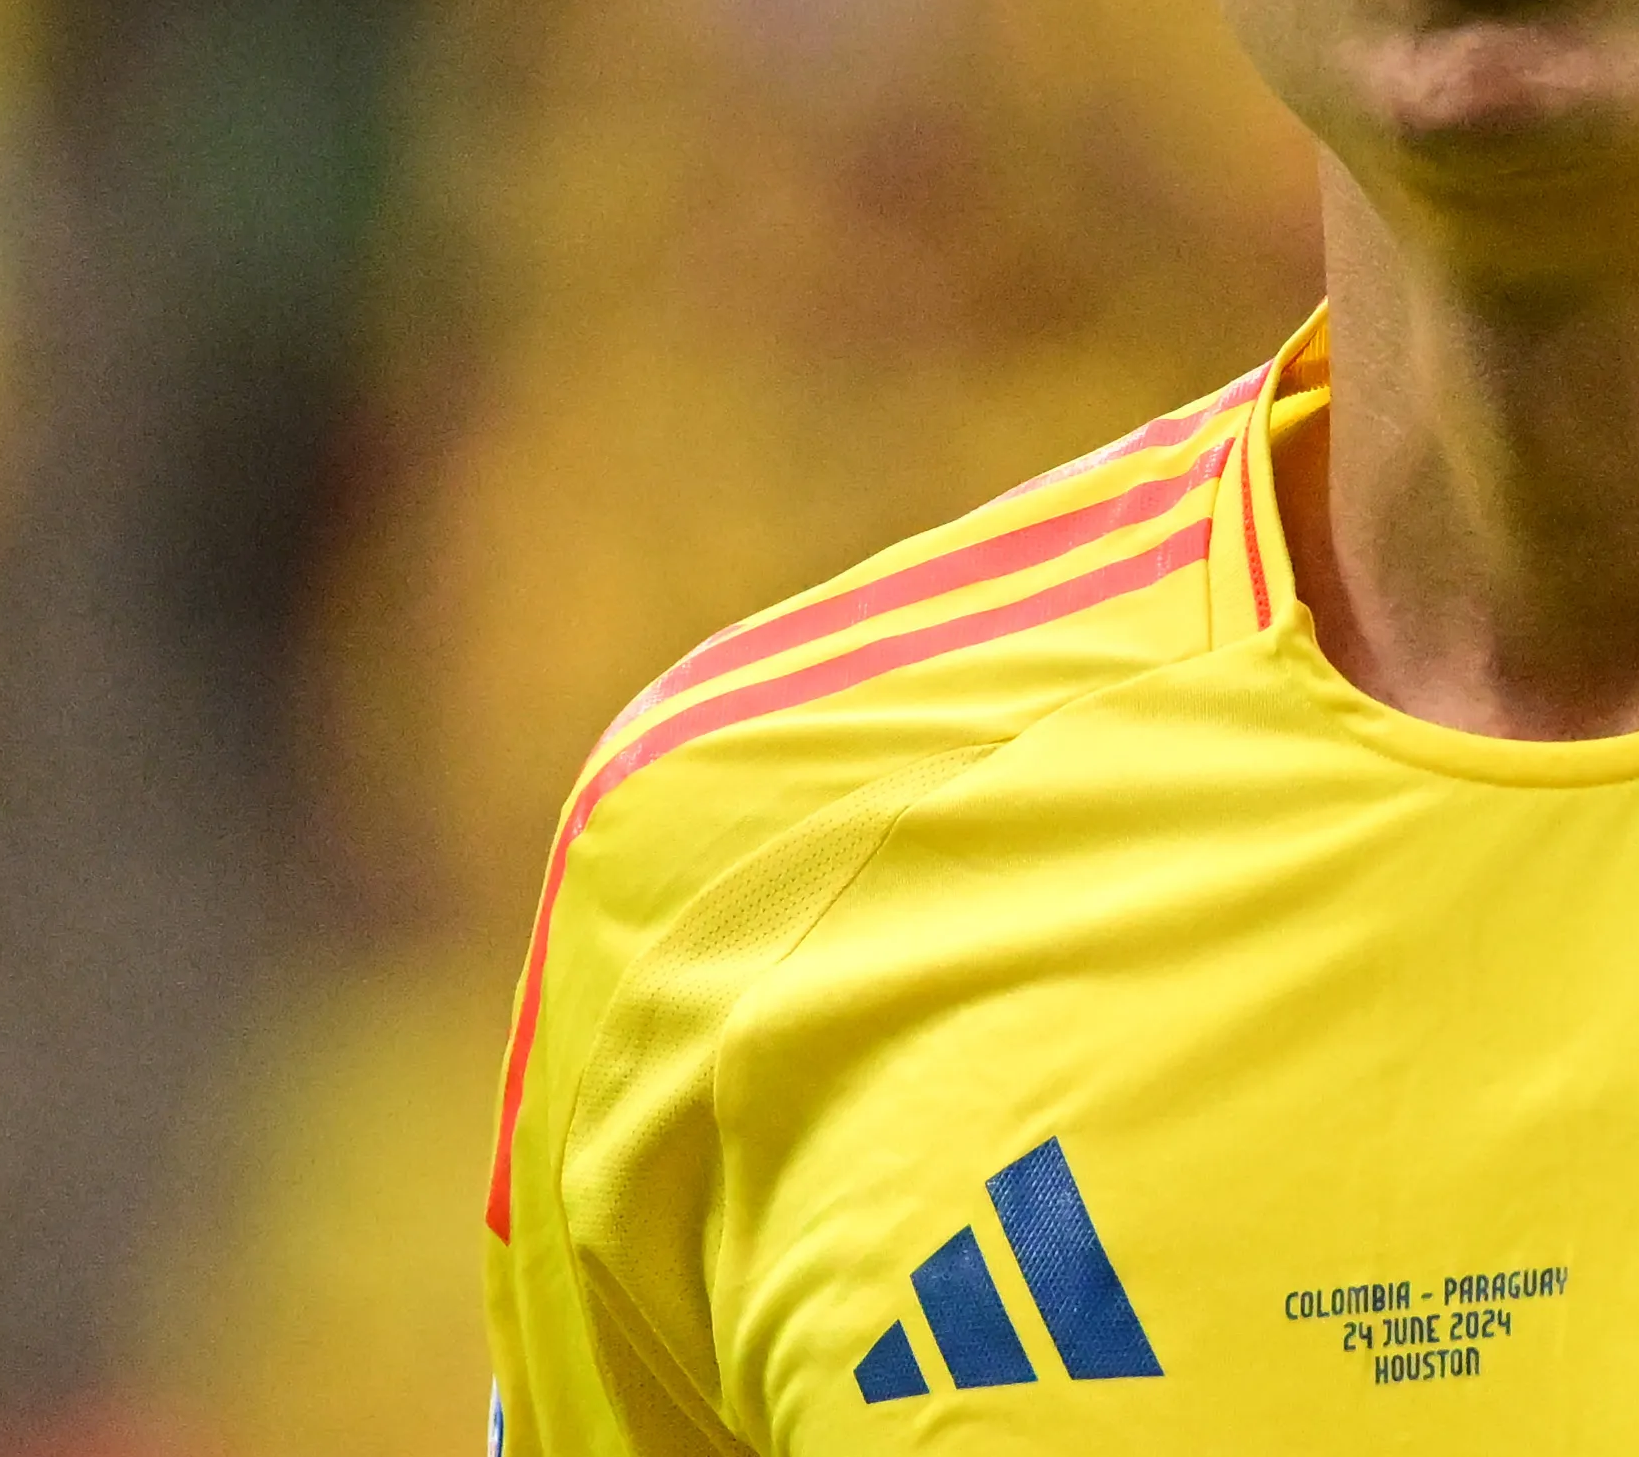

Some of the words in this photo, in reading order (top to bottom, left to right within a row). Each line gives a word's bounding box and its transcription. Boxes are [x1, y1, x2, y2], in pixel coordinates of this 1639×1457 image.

[1284, 1279, 1411, 1320] COLOMBIA
[1443, 1266, 1569, 1307] PARAGUAY
[1342, 1321, 1374, 1351] 24
[1382, 1314, 1441, 1347] JUNE
[1448, 1309, 1512, 1341] 2024
[1374, 1346, 1481, 1385] HOUSTON
